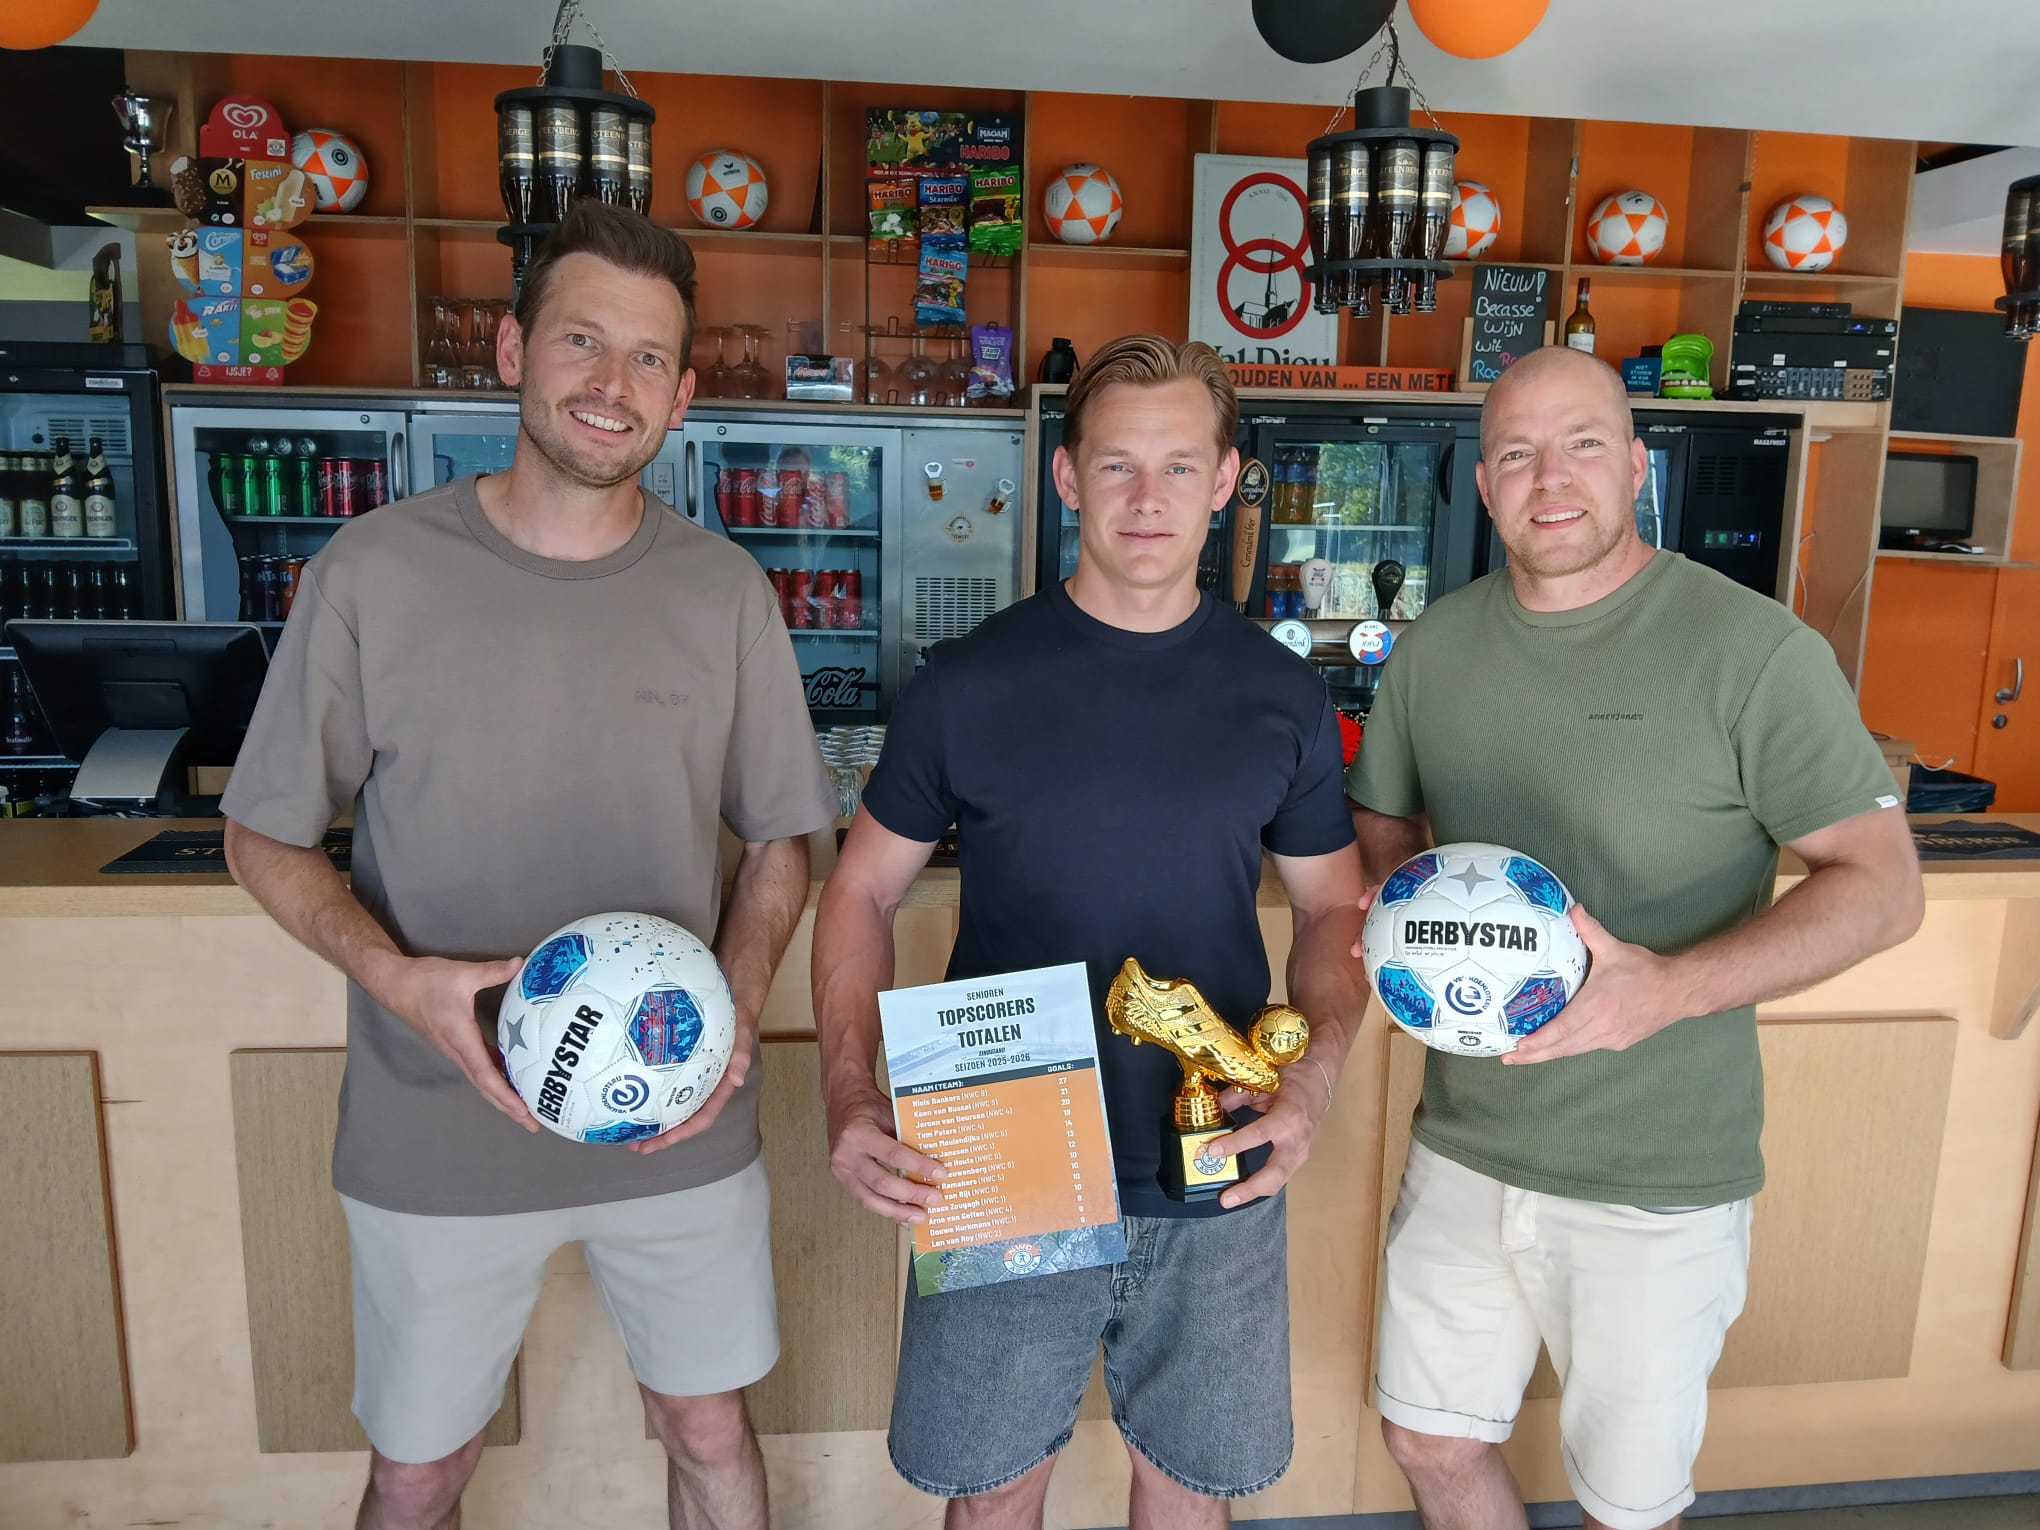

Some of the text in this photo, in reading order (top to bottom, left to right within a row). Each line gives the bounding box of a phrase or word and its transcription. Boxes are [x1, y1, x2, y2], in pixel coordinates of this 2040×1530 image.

[232, 129, 258, 140] OLA
[960, 145, 1011, 160] HARIBO
[977, 176, 1016, 188] HARIBO
[873, 188, 913, 200] HARIBO
[924, 184, 964, 195] HARIBO
[925, 256, 963, 271] HARIBO
[1476, 296, 1535, 317] Becasse
[226, 367, 252, 377] IJSJE?
[1299, 371, 1337, 389] VAN
[1365, 372, 1402, 390] EEN
[1404, 920, 1538, 952] DERBYSTAR
[966, 987, 1003, 1001] SENIOREN
[937, 997, 1036, 1027] TOPSCORERS
[957, 1023, 1021, 1048] TOTALEN
[536, 1004, 604, 1124] DERBYSTAR
[954, 1052, 1030, 1072] SEIZOEN 2025-2026
[911, 1084, 933, 1094] NAAM
[1046, 1062, 1073, 1072] GOALS:
[1057, 1076, 1067, 1084] 27
[961, 1090, 979, 1100] (NWC
[1059, 1087, 1068, 1095] 21
[913, 1109, 931, 1118] Koen
[971, 1099, 990, 1109] (NWC
[914, 1119, 940, 1128] Jeroen
[985, 1108, 1004, 1118] (NWC
[1064, 1118, 1072, 1126] 14
[916, 1130, 932, 1139] Tom
[933, 1127, 957, 1136] Peters
[957, 1123, 976, 1133] (NWC
[918, 1140, 937, 1150] Twan
[980, 1130, 999, 1140] (NWC
[969, 1143, 988, 1153] (NWC
[988, 1142, 995, 1150] 1)
[974, 1153, 993, 1163] (NWC
[1069, 1150, 1077, 1158] 10
[987, 1162, 1006, 1172] (NWC
[1070, 1161, 1079, 1169] 10
[1200, 1162, 1225, 1174] ASTEN
[977, 1174, 996, 1184] (NWC
[944, 1192, 957, 1200] van
[971, 1186, 990, 1196] (NWC
[1073, 1183, 1082, 1191] 10
[980, 1195, 999, 1205] (NWC
[928, 1216, 945, 1225] Arno
[985, 1206, 1004, 1216] (NWC
[929, 1225, 953, 1236] Douwe
[991, 1216, 1010, 1226] (NWC
[960, 1234, 974, 1243] Roy
[974, 1230, 993, 1240] (NWC
[1008, 1244, 1033, 1255] NWC
